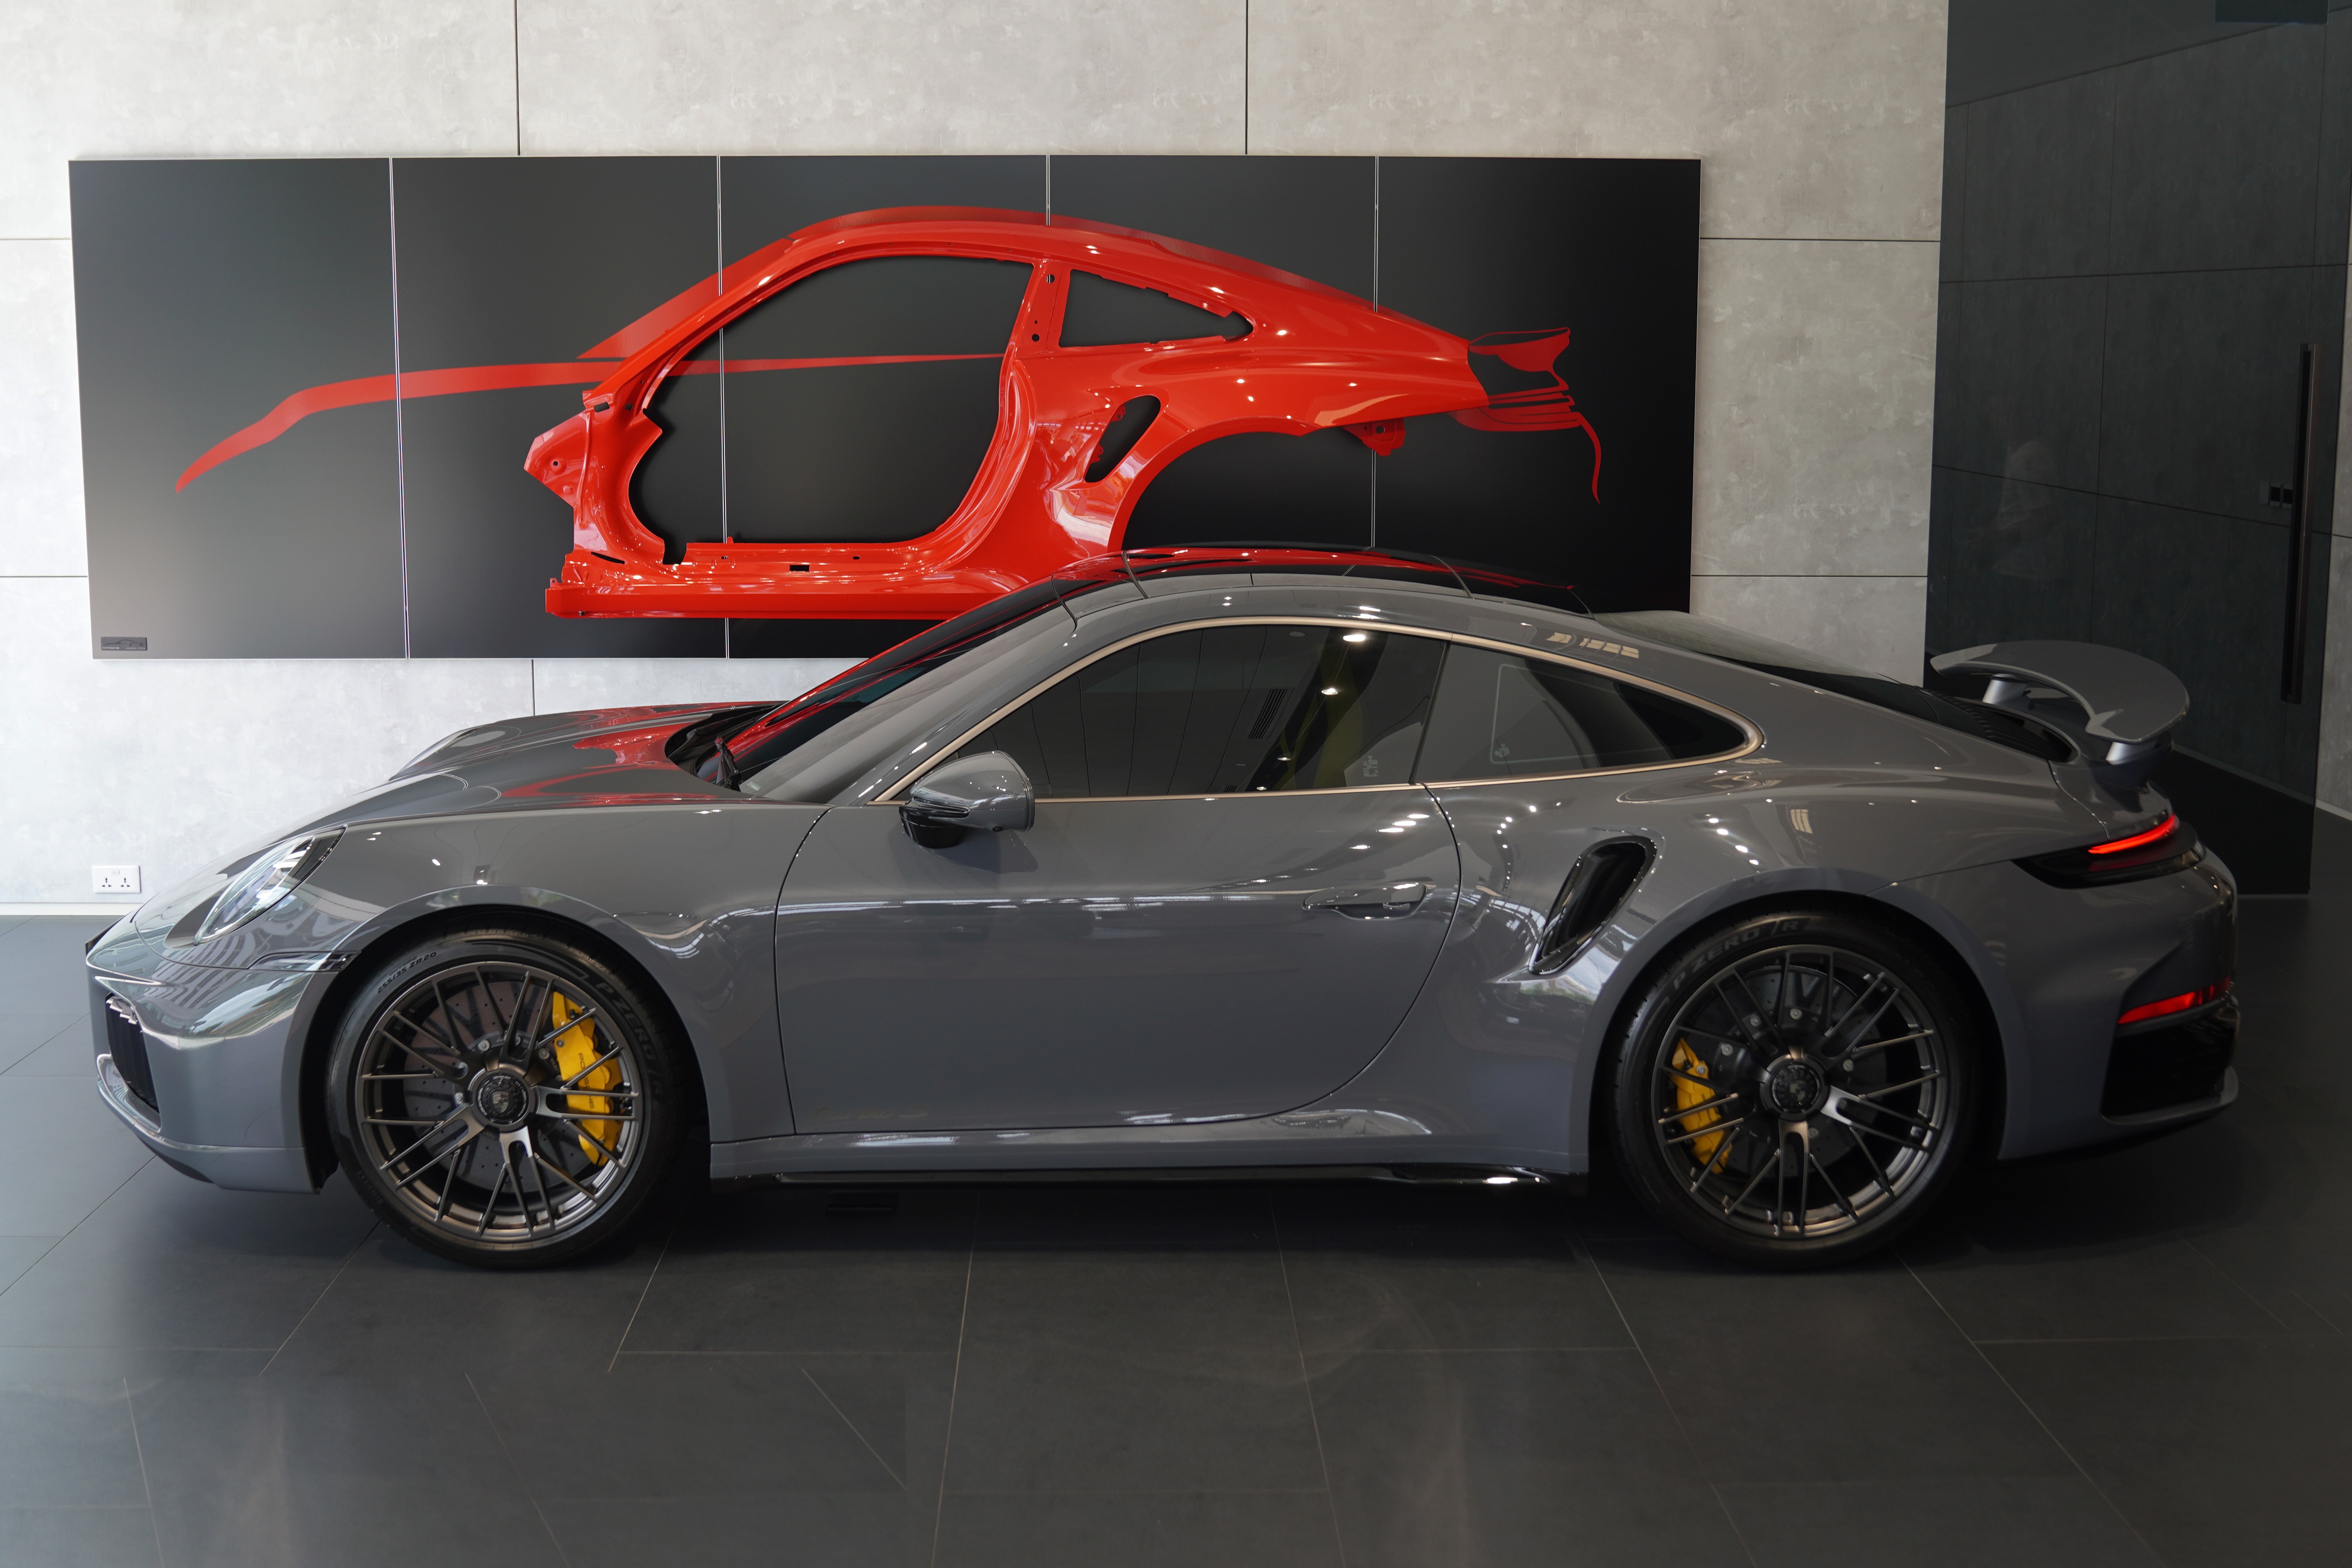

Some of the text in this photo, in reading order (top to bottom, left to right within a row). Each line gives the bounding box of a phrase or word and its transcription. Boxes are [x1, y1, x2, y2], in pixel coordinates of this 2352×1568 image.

[378, 951, 437, 994] 255/35 ZR20
[1673, 920, 1799, 991] P ZERO R
[596, 982, 614, 995] P
[612, 998, 657, 1060] ZERO
